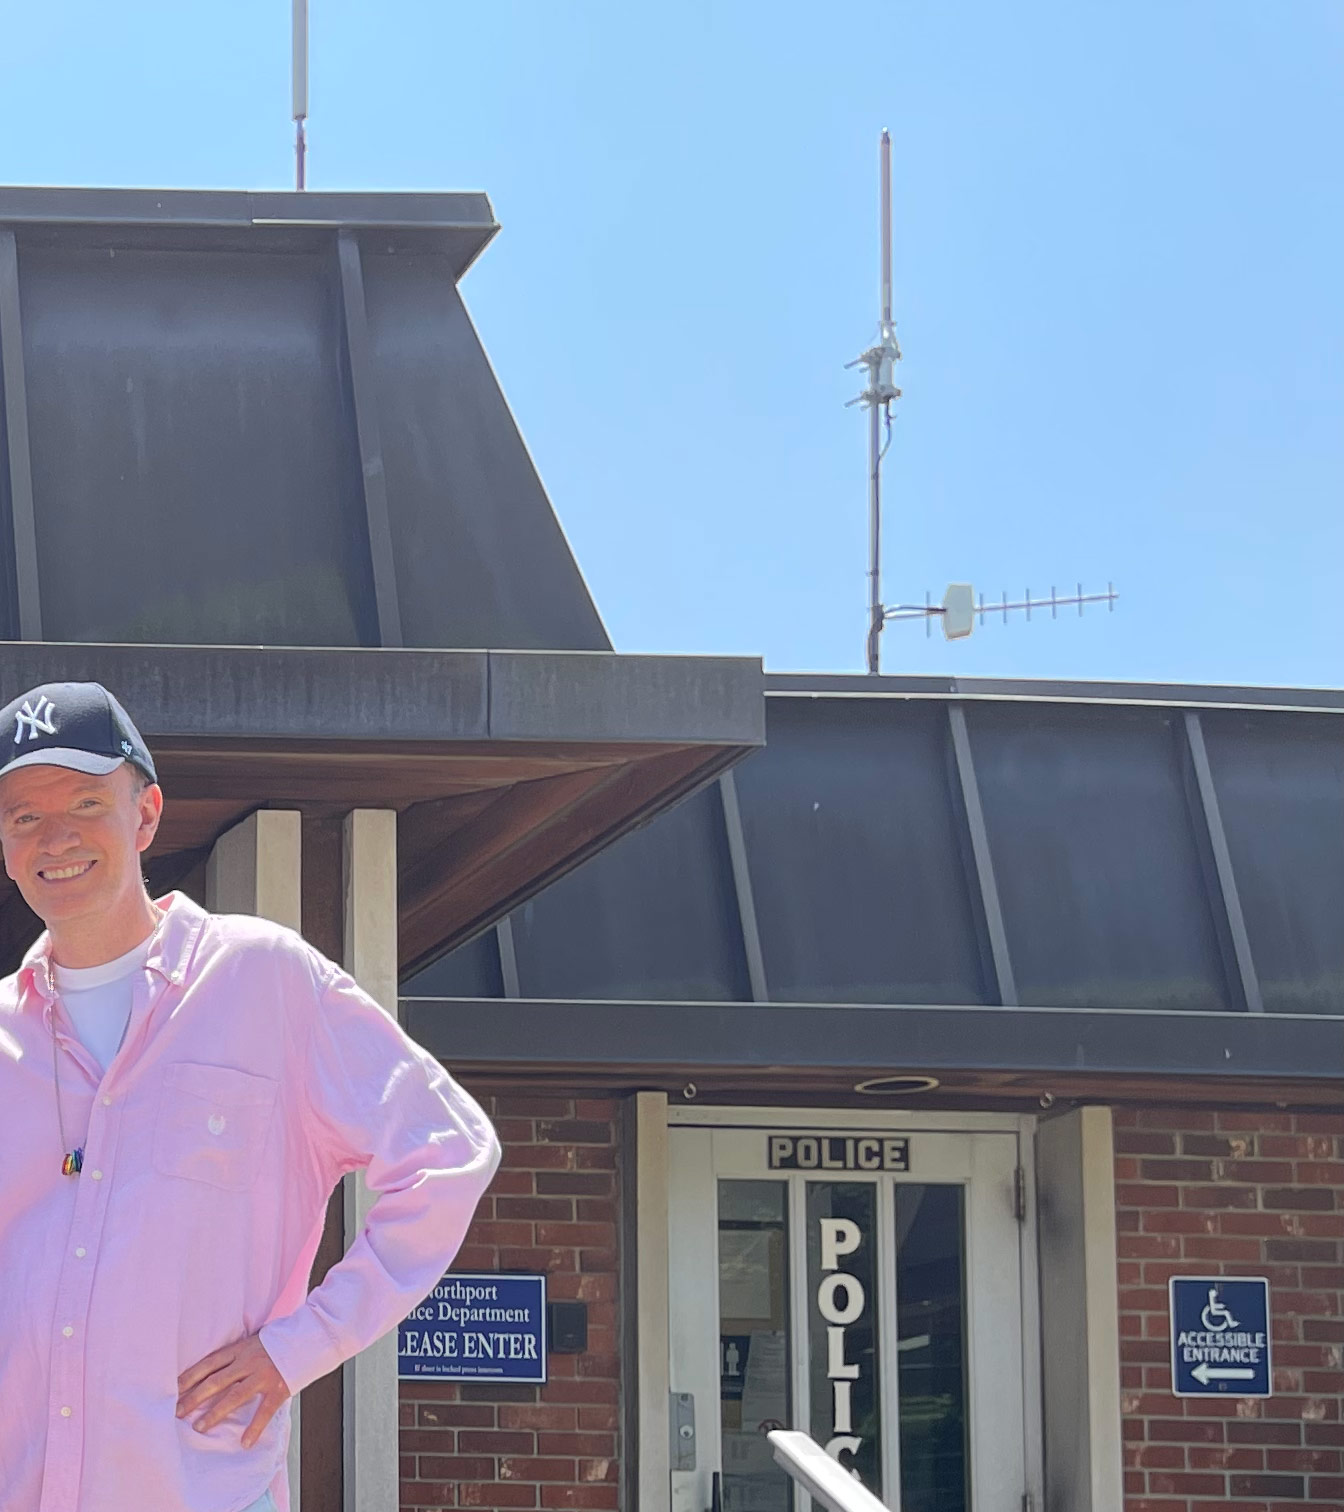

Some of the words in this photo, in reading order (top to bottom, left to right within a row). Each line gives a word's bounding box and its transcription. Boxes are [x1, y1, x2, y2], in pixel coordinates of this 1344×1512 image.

[14, 695, 58, 745] NY
[770, 1137, 906, 1170] POLICE
[437, 1301, 530, 1328] Department
[398, 1330, 458, 1358] LEASE
[462, 1331, 538, 1360] ENTER
[1177, 1330, 1266, 1349] ACCESSIBLE
[1183, 1346, 1261, 1363] ENTRANCE
